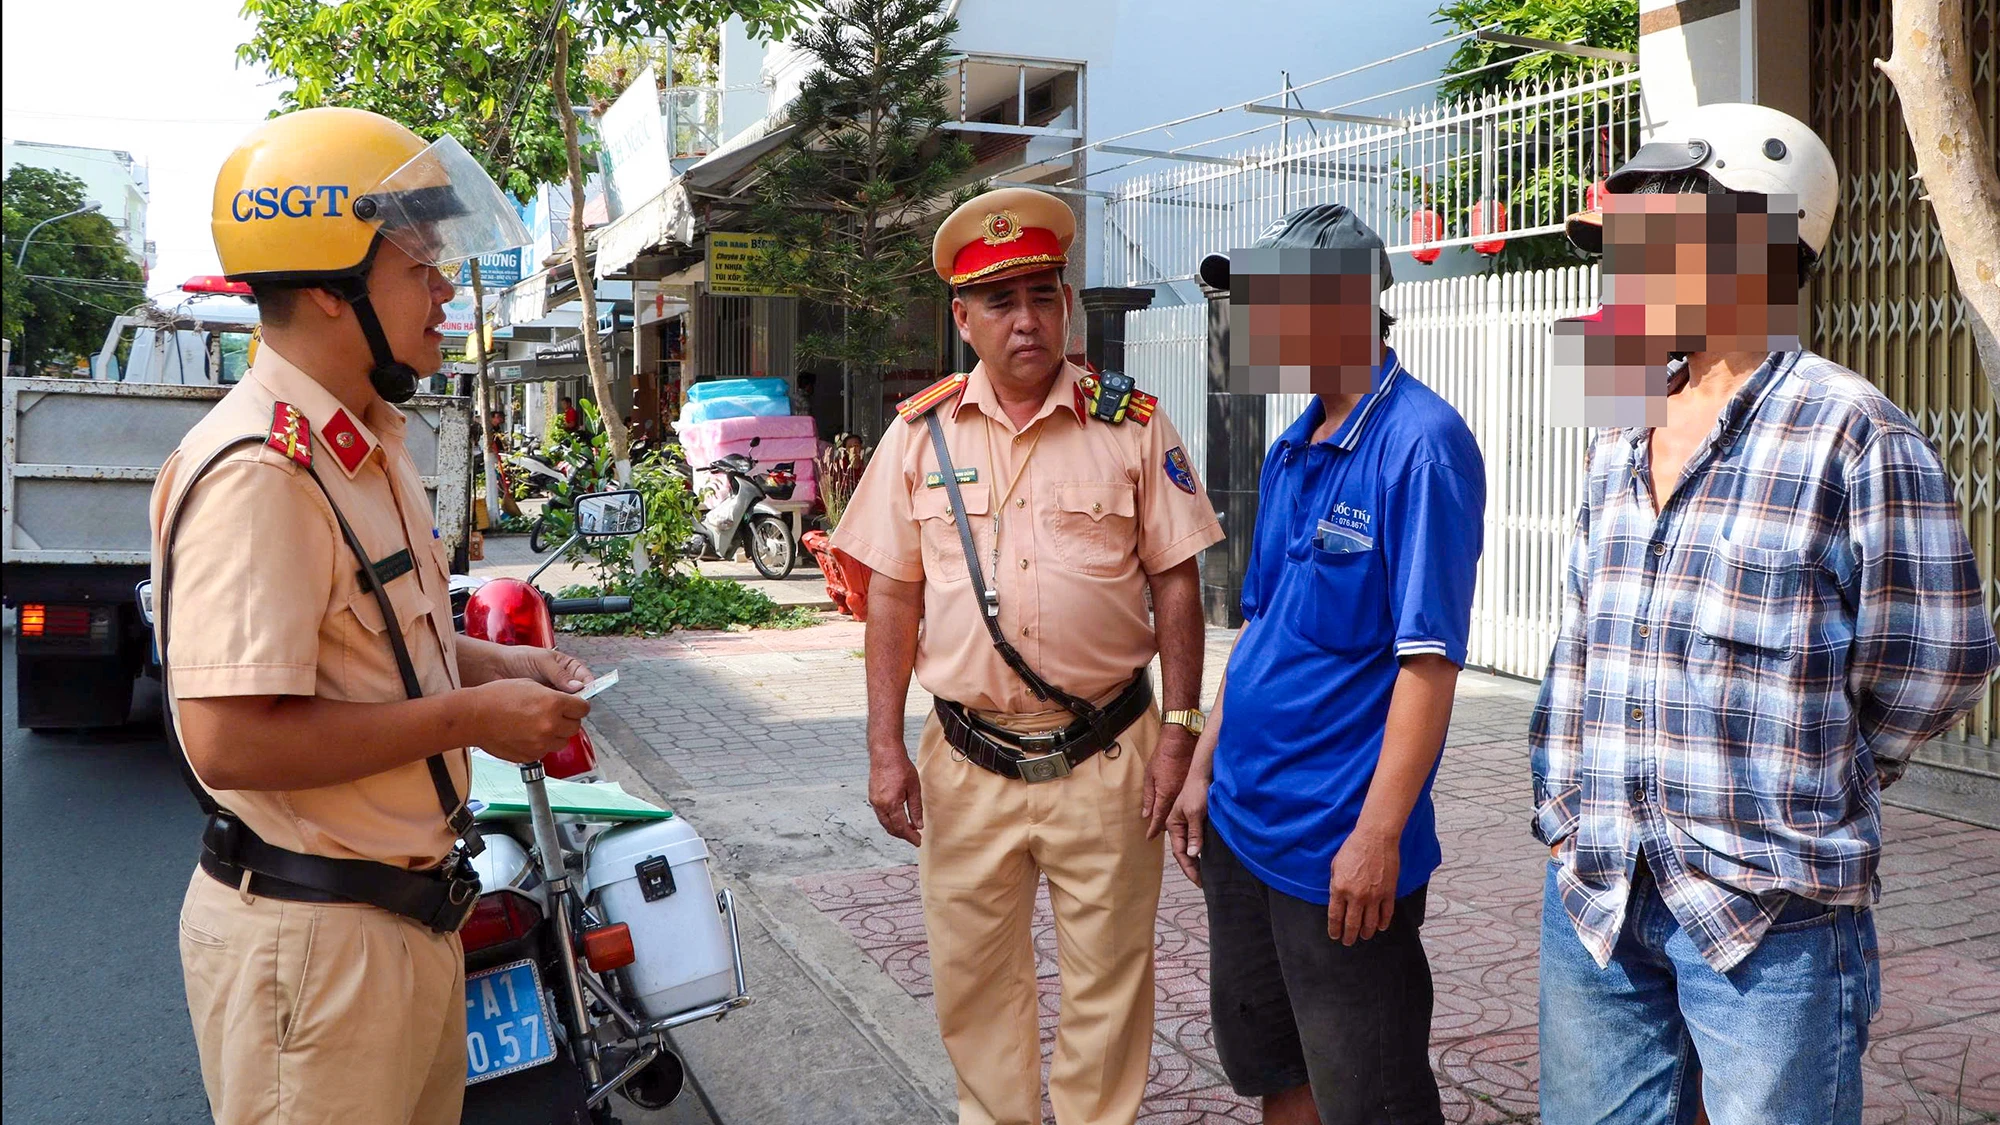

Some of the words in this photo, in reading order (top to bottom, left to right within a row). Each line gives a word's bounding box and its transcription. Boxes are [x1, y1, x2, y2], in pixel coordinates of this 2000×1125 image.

[232, 185, 348, 222] CSGT
[468, 252, 517, 268] HƯƠNG
[1333, 501, 1351, 517] UỐC
[467, 972, 518, 1020] -A1
[466, 1014, 539, 1074] 0.57
